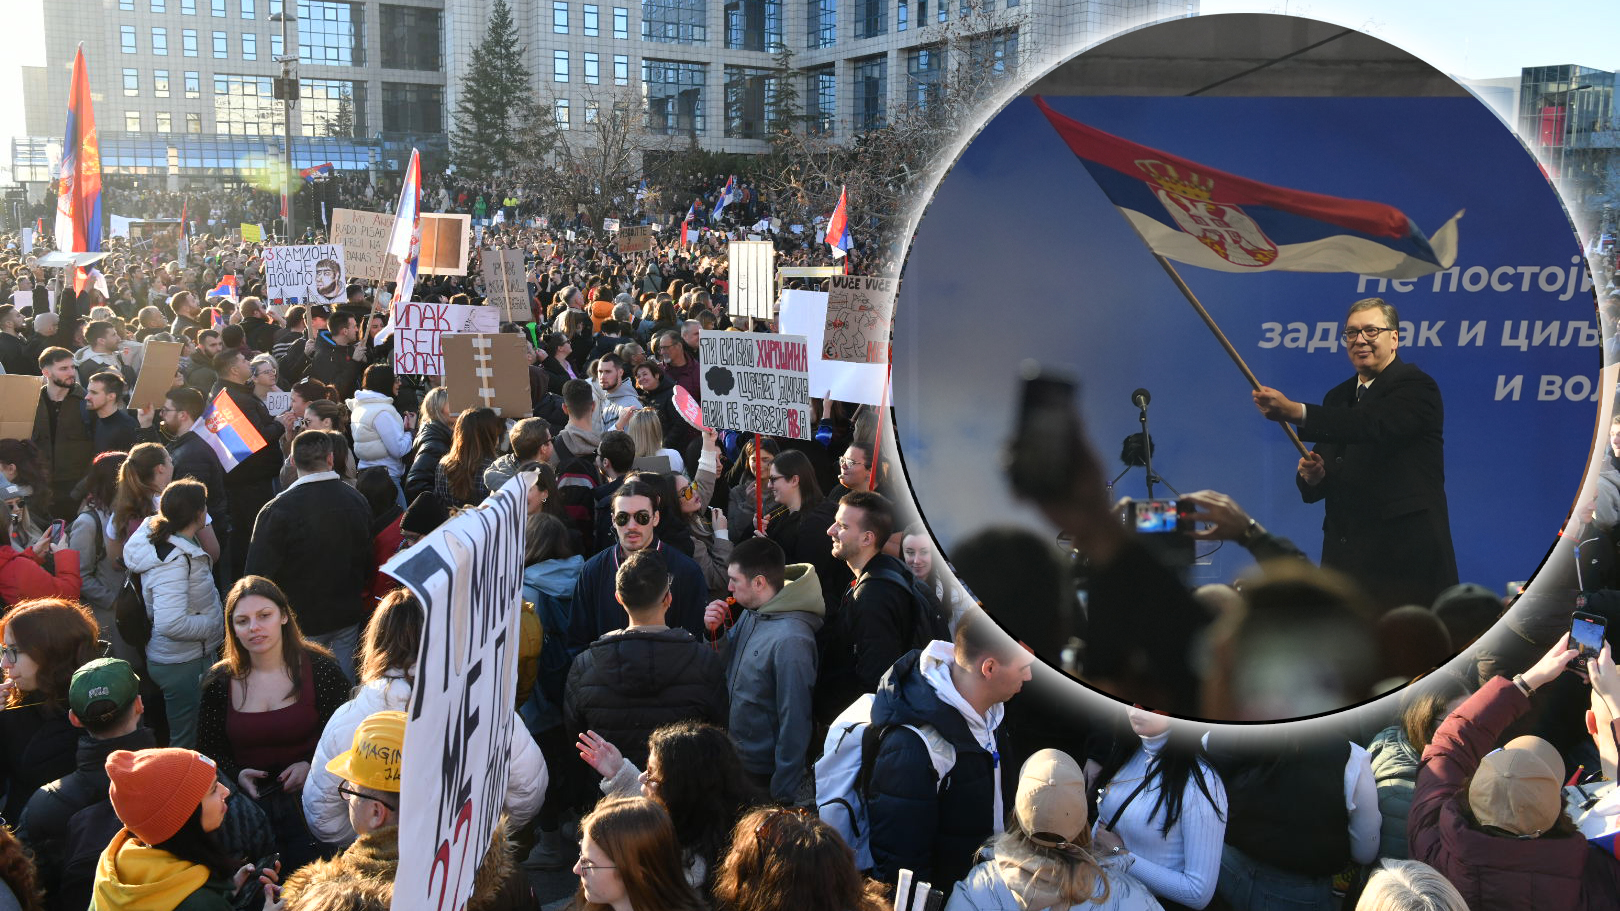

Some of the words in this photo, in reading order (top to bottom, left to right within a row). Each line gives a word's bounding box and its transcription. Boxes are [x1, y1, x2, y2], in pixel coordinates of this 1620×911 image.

[276, 245, 338, 260] КАМИОНА
[266, 260, 292, 274] НАС
[295, 259, 313, 274] ЈЕ
[268, 273, 313, 288] ДОШЛО
[833, 276, 860, 289] VUČE
[865, 278, 892, 292] VUČE
[394, 303, 451, 331] ИПАК
[1258, 320, 1445, 353] задак
[1457, 320, 1487, 347] и
[700, 338, 718, 365] ТИ
[720, 338, 735, 366] СИ
[1494, 375, 1523, 401] и
